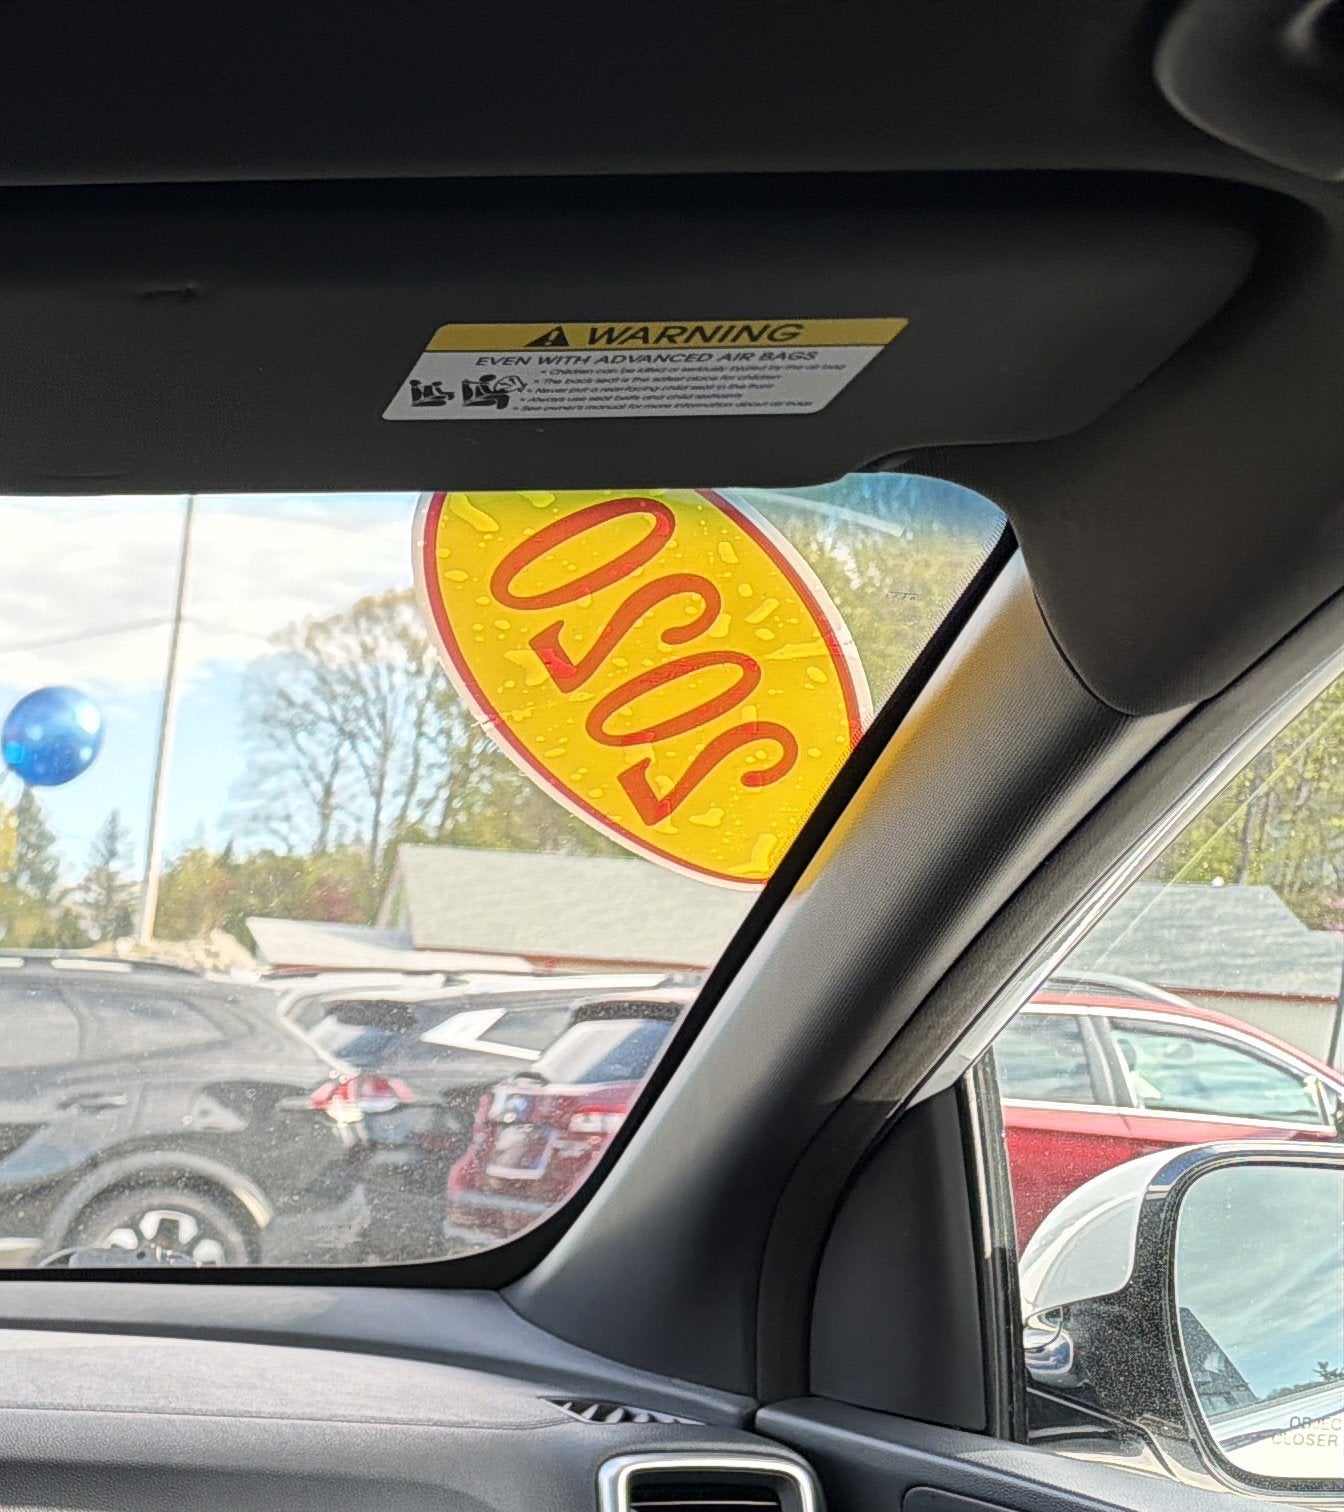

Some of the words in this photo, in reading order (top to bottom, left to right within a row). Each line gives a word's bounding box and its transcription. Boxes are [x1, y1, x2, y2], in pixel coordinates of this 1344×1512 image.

[588, 323, 806, 344] WARNING
[476, 356, 534, 367] EVEN
[538, 355, 591, 366] WITH
[597, 353, 714, 365] ADVANCED
[718, 352, 755, 362] AIR
[759, 351, 818, 361] BAGS
[1272, 1432, 1339, 1447] CLOSER
